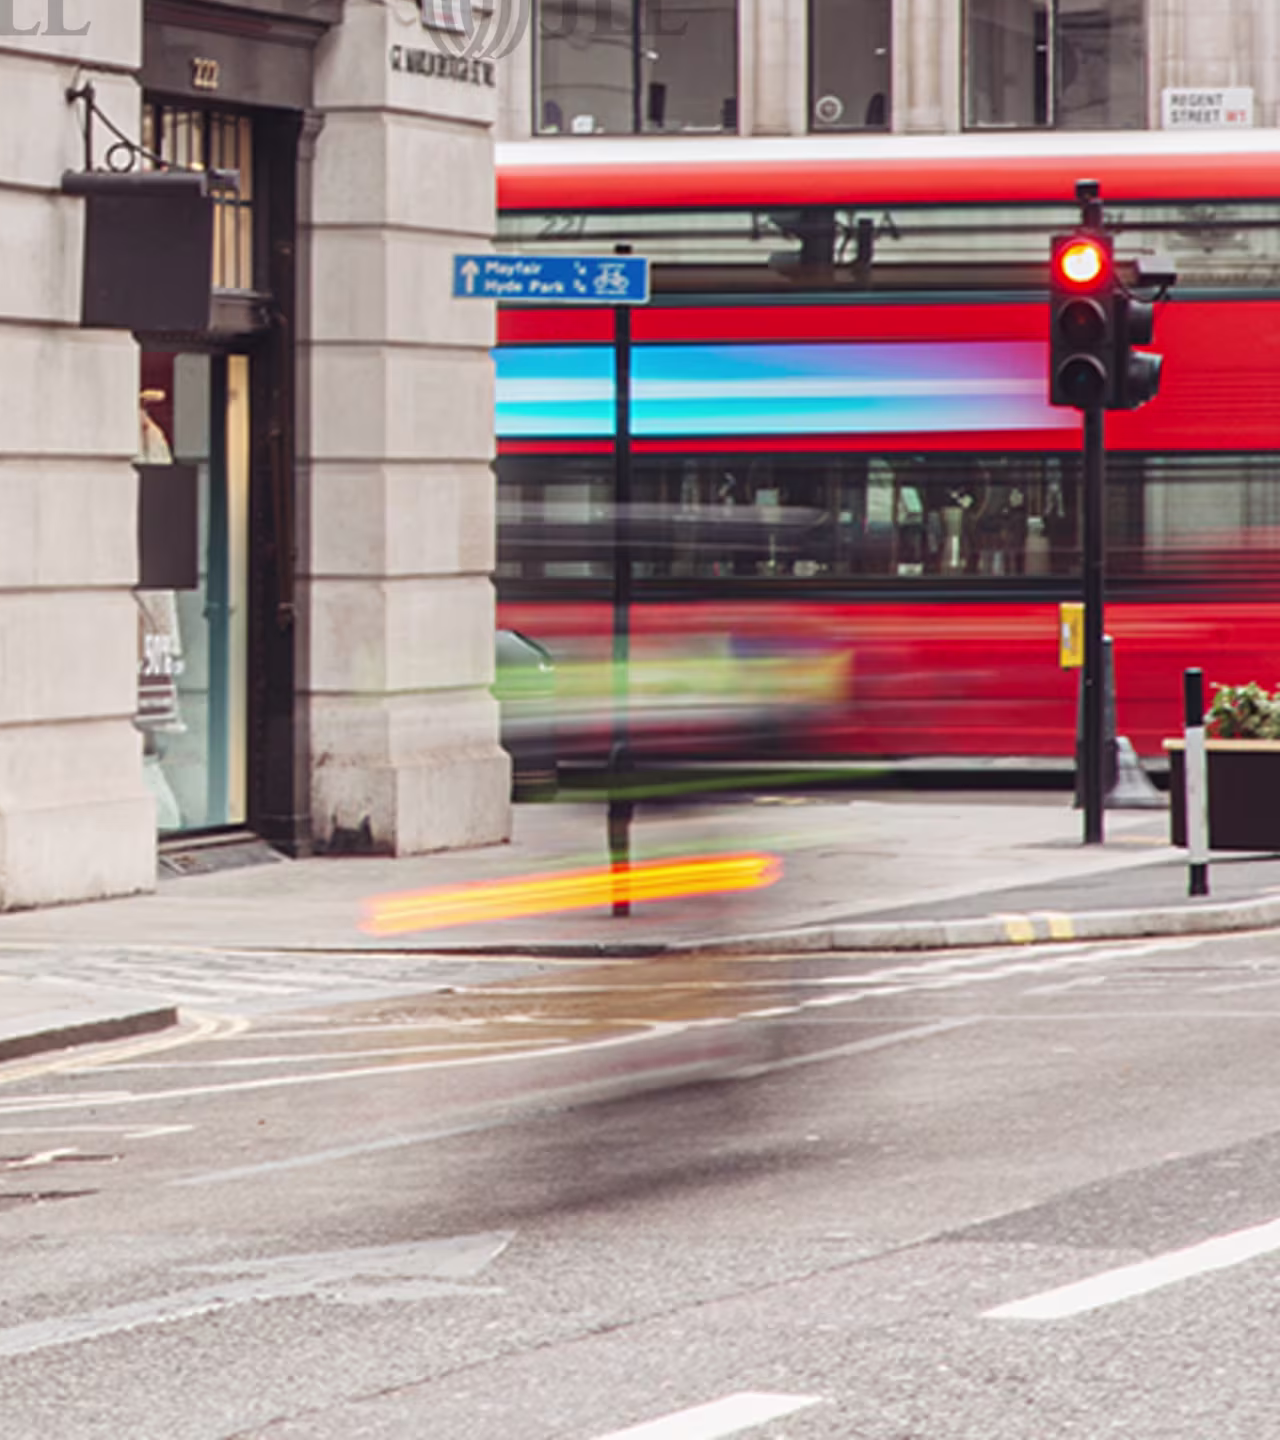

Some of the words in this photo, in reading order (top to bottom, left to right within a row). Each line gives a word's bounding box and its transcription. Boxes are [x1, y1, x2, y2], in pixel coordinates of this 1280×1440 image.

[485, 261, 542, 276] Mayfair
[484, 279, 523, 295] Hyde
[528, 279, 564, 293] Park
